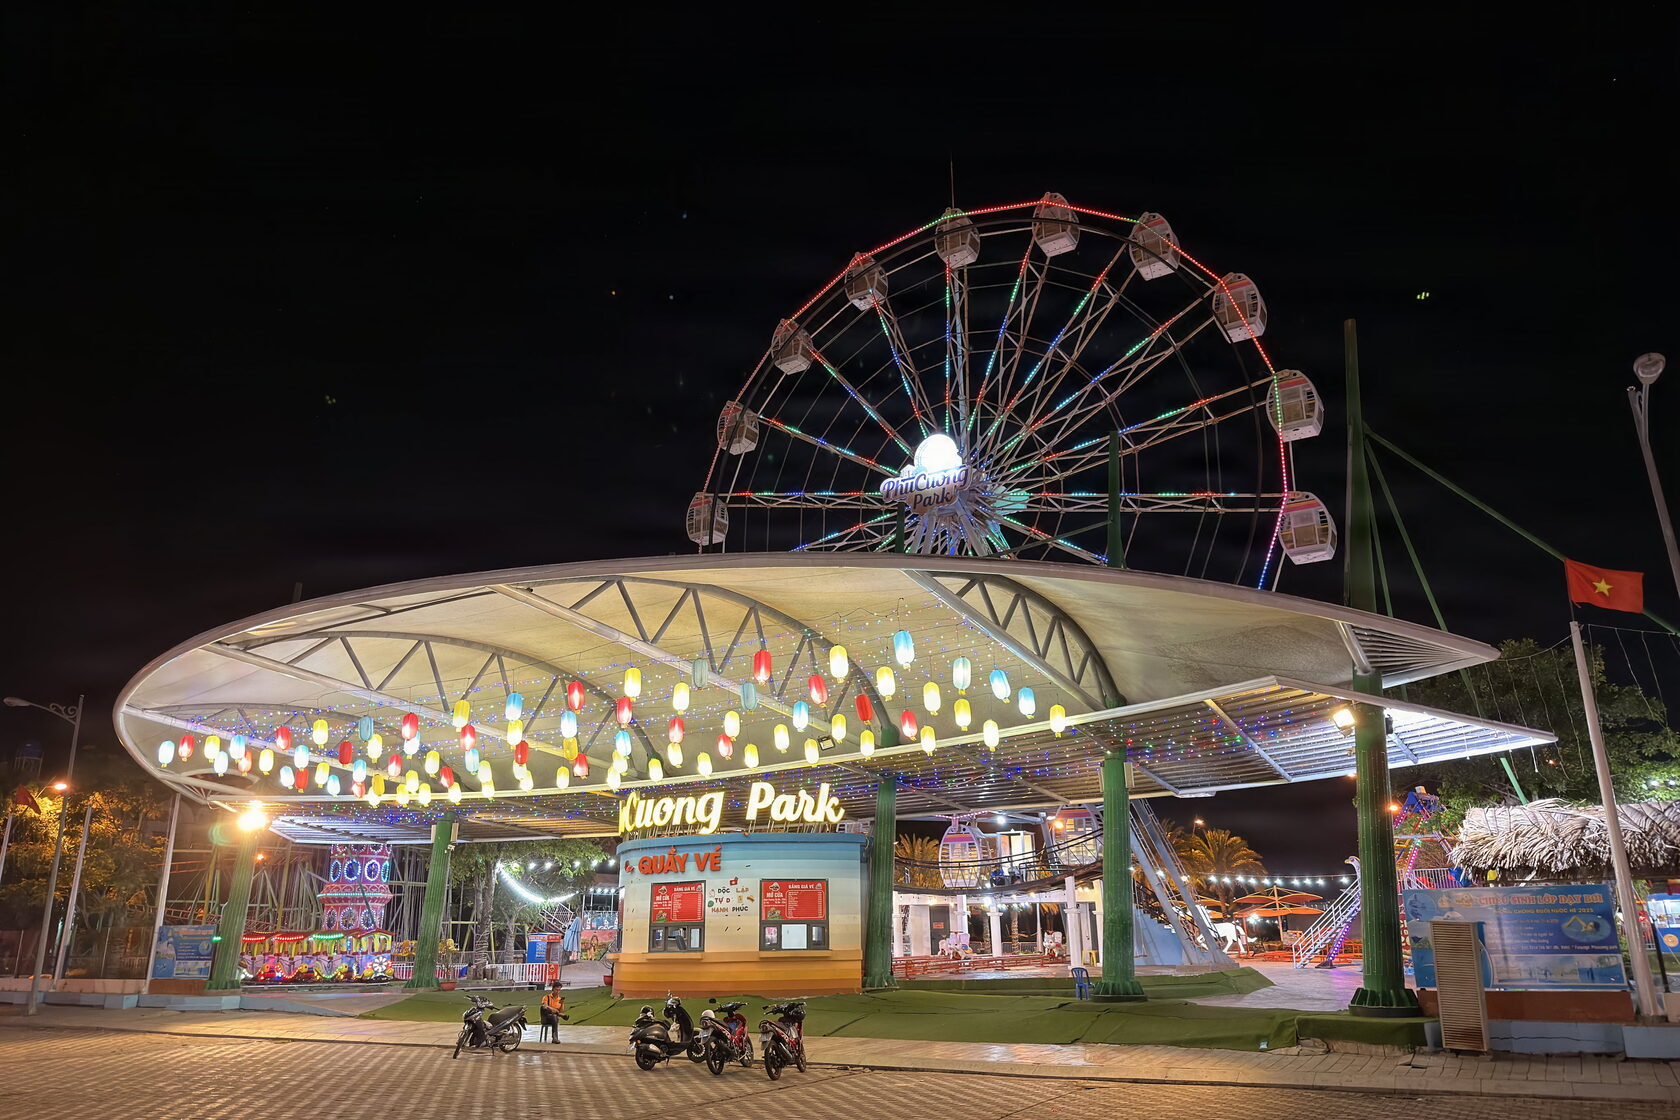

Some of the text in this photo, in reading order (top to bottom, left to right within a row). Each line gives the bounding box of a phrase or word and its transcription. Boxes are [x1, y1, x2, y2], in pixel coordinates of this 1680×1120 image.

[912, 487, 953, 510] Park
[745, 782, 846, 823] Park
[694, 845, 722, 872] VÉ
